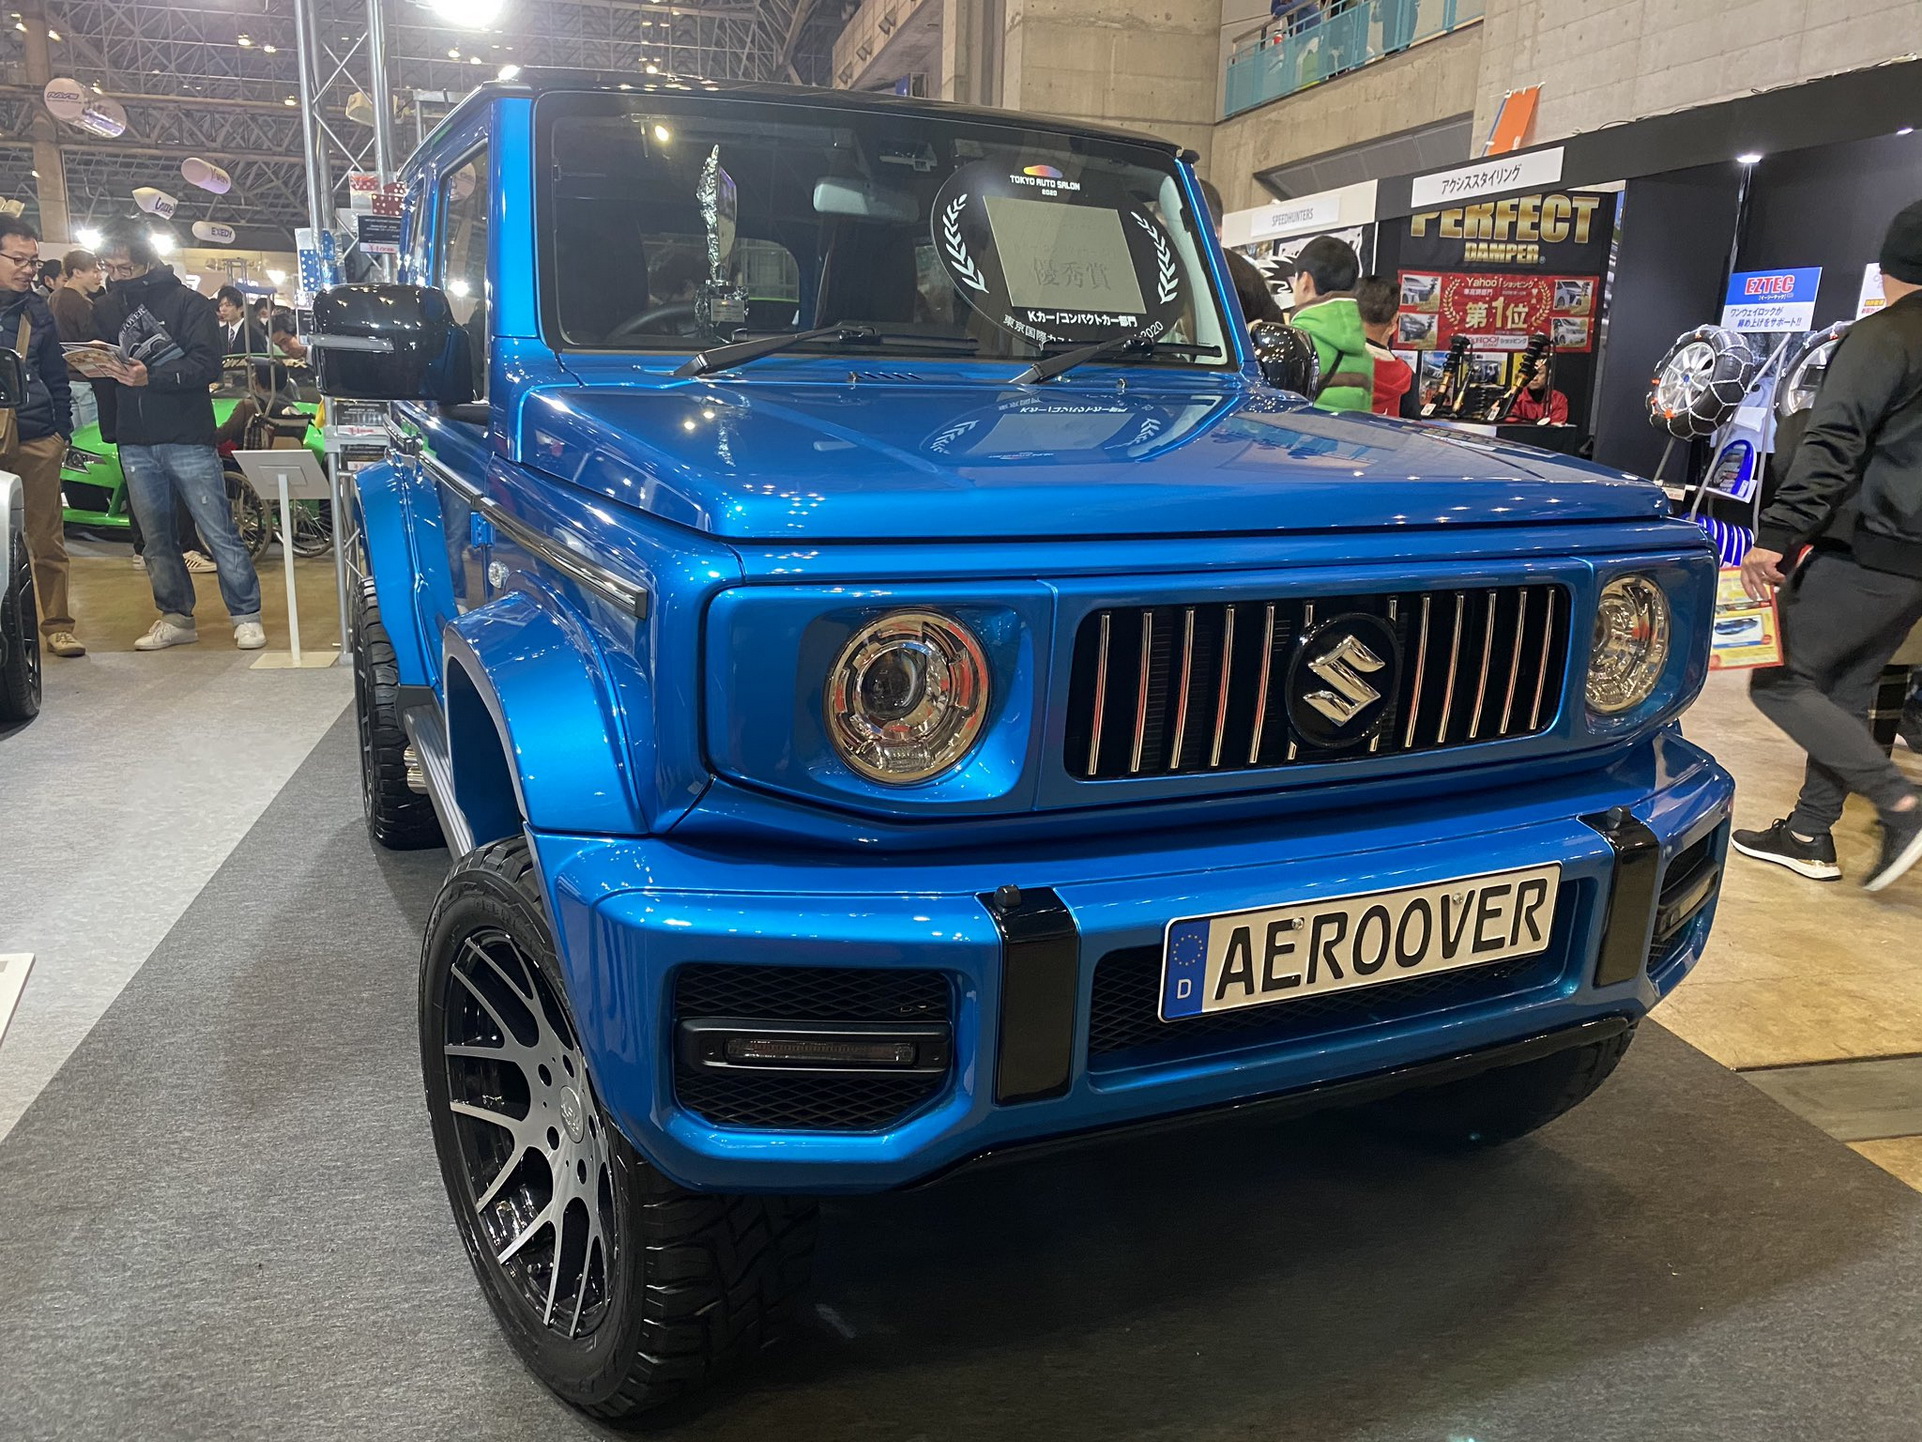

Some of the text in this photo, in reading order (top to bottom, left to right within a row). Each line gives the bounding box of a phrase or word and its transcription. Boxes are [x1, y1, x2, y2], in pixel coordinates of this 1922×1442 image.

[1009, 174, 1081, 191] TOKYO AUTO SALON
[1441, 163, 1522, 195] アクシススタイリング
[1041, 188, 1058, 197] 2020
[1271, 207, 1314, 227] SPEEDHUNTERS
[1463, 241, 1540, 264] DAMPER
[1466, 277, 1502, 288] Yahoo!
[1745, 274, 1795, 295] EZTEC
[1465, 296, 1529, 329] 第1位
[1730, 306, 1784, 318] ワンウェイロックが
[1214, 877, 1548, 1001] AEROOVER
[1176, 978, 1192, 1000] D
